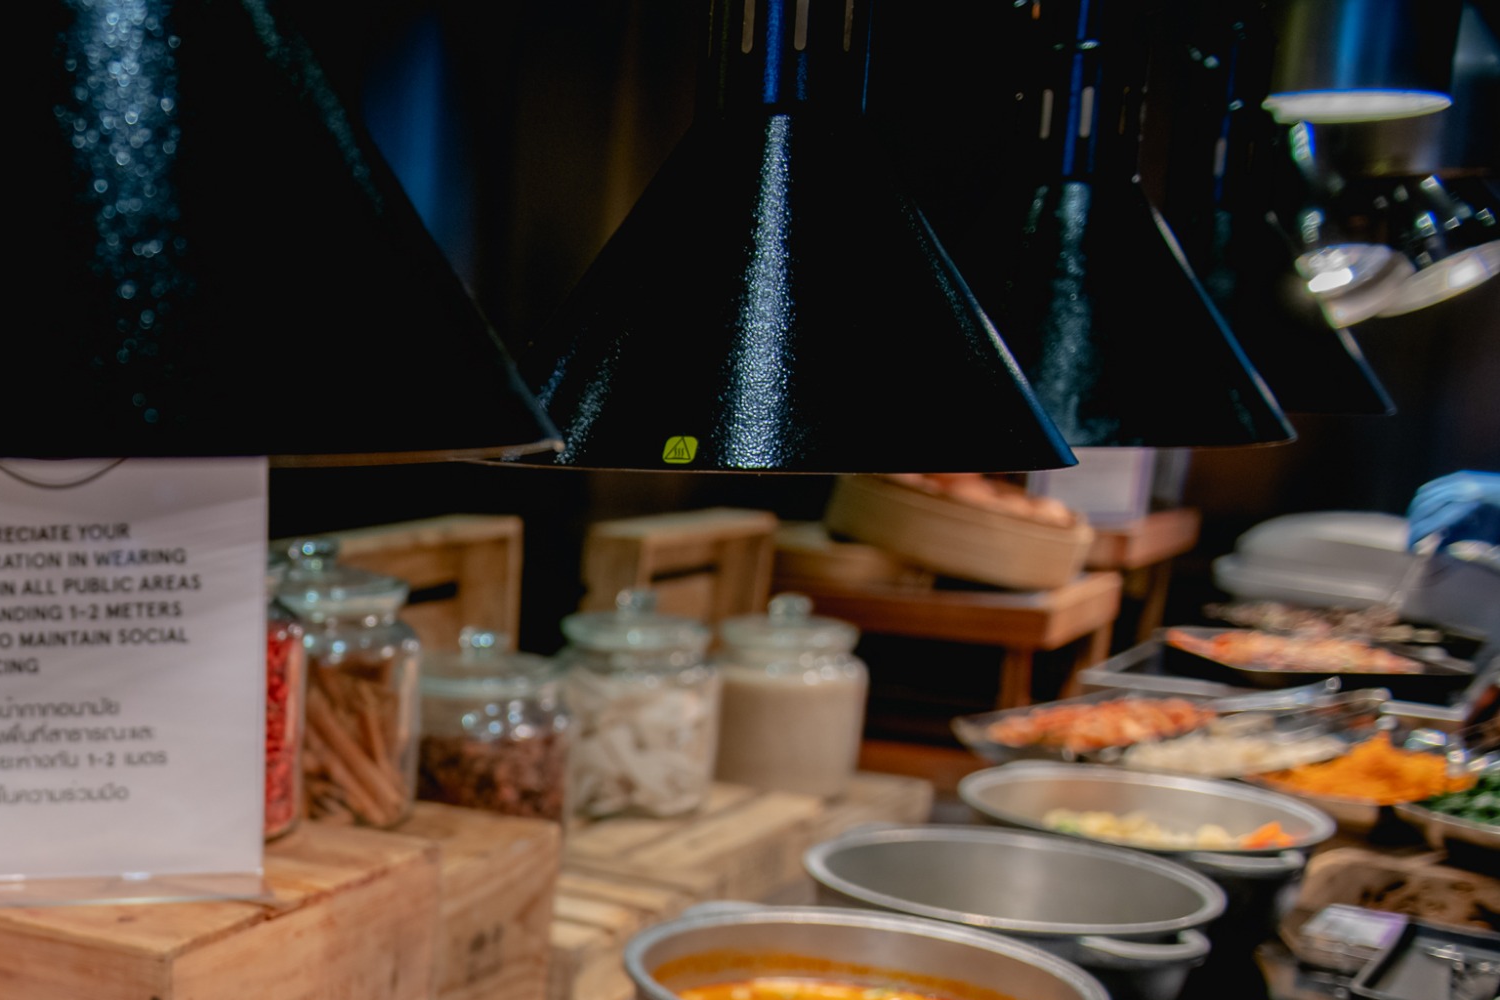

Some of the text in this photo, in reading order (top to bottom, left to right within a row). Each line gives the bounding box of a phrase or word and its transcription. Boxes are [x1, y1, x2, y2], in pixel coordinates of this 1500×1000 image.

[78, 522, 131, 541] YOUR
[68, 551, 87, 568] IN
[95, 548, 186, 567] WEARING
[21, 579, 57, 596] ALL
[63, 576, 133, 595] PUBLIC
[138, 574, 201, 593] AREAS
[69, 604, 99, 621] 1-2
[105, 601, 182, 619] METERS
[19, 630, 111, 648] MAINTAIN
[117, 627, 189, 646] SOCIAL
[87, 752, 115, 767] 1-2
